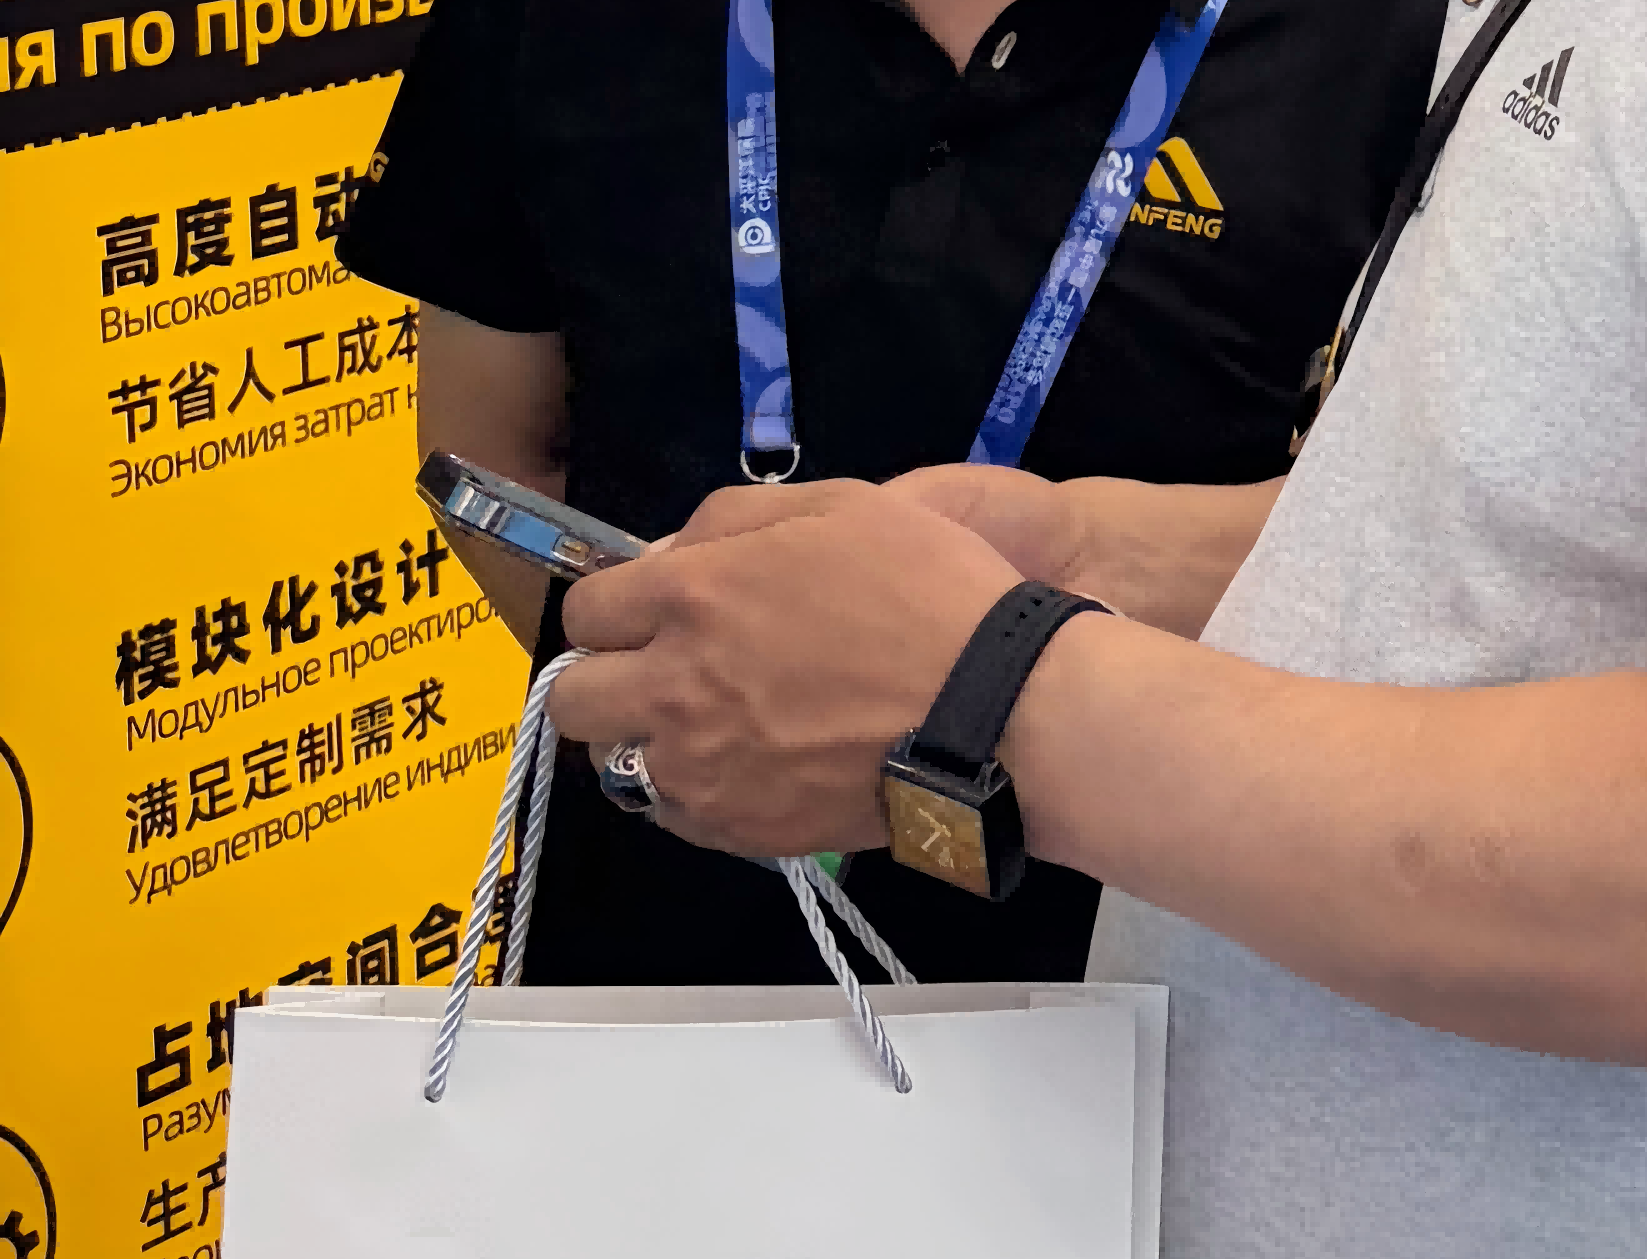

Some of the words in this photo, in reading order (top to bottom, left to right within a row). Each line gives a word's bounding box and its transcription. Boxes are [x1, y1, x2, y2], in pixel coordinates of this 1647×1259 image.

[81, 10, 175, 78] по
[1502, 89, 1560, 141] adidas
[108, 303, 420, 445] 节省人工成本
[109, 421, 287, 500] Экономия
[293, 387, 400, 446] затрат
[115, 528, 450, 706] 模块化设计
[126, 656, 322, 752] Модульное
[329, 597, 500, 680] проектиро
[125, 675, 450, 855] 满足定制需求
[125, 765, 401, 905] Удовлетворение
